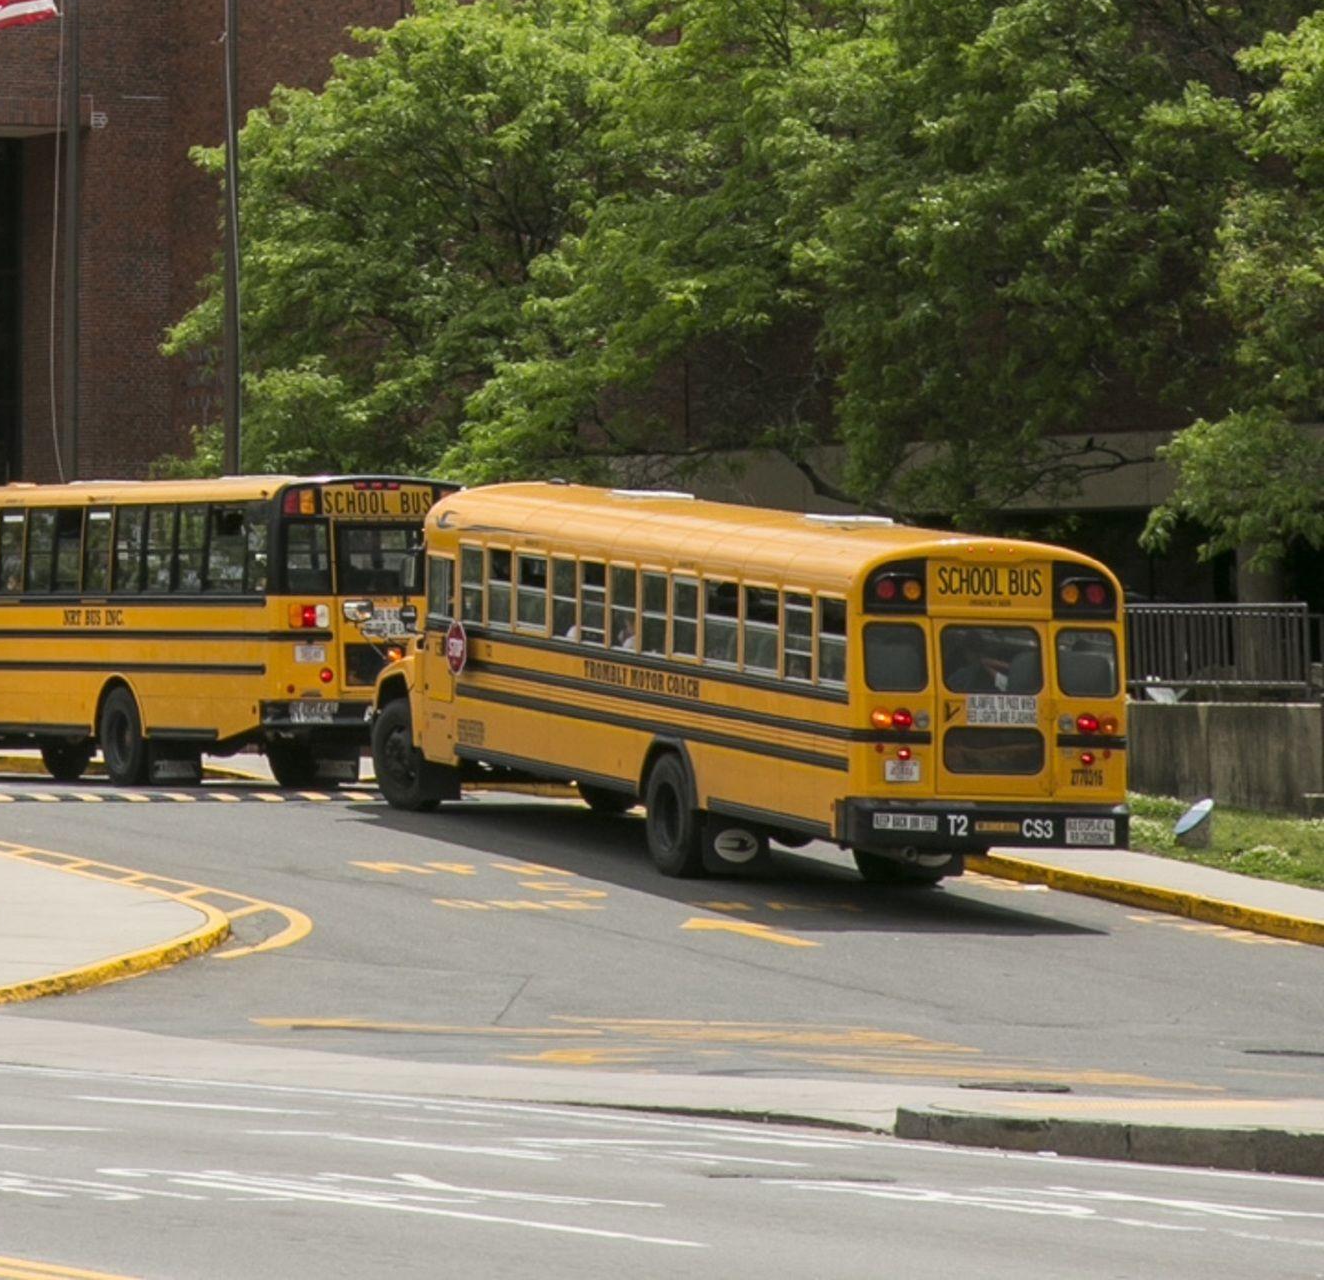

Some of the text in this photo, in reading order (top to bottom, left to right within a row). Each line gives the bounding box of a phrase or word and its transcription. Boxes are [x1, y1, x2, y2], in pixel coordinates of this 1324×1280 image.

[324, 491, 431, 515] SCHOOL BUS
[938, 567, 1042, 596] SCHOOL BUS
[85, 610, 102, 626] BUS
[105, 610, 125, 625] INC.
[584, 660, 700, 697] TROMBLY MOTOR COACH
[947, 815, 968, 836] T2
[1022, 818, 1054, 839] CS3
